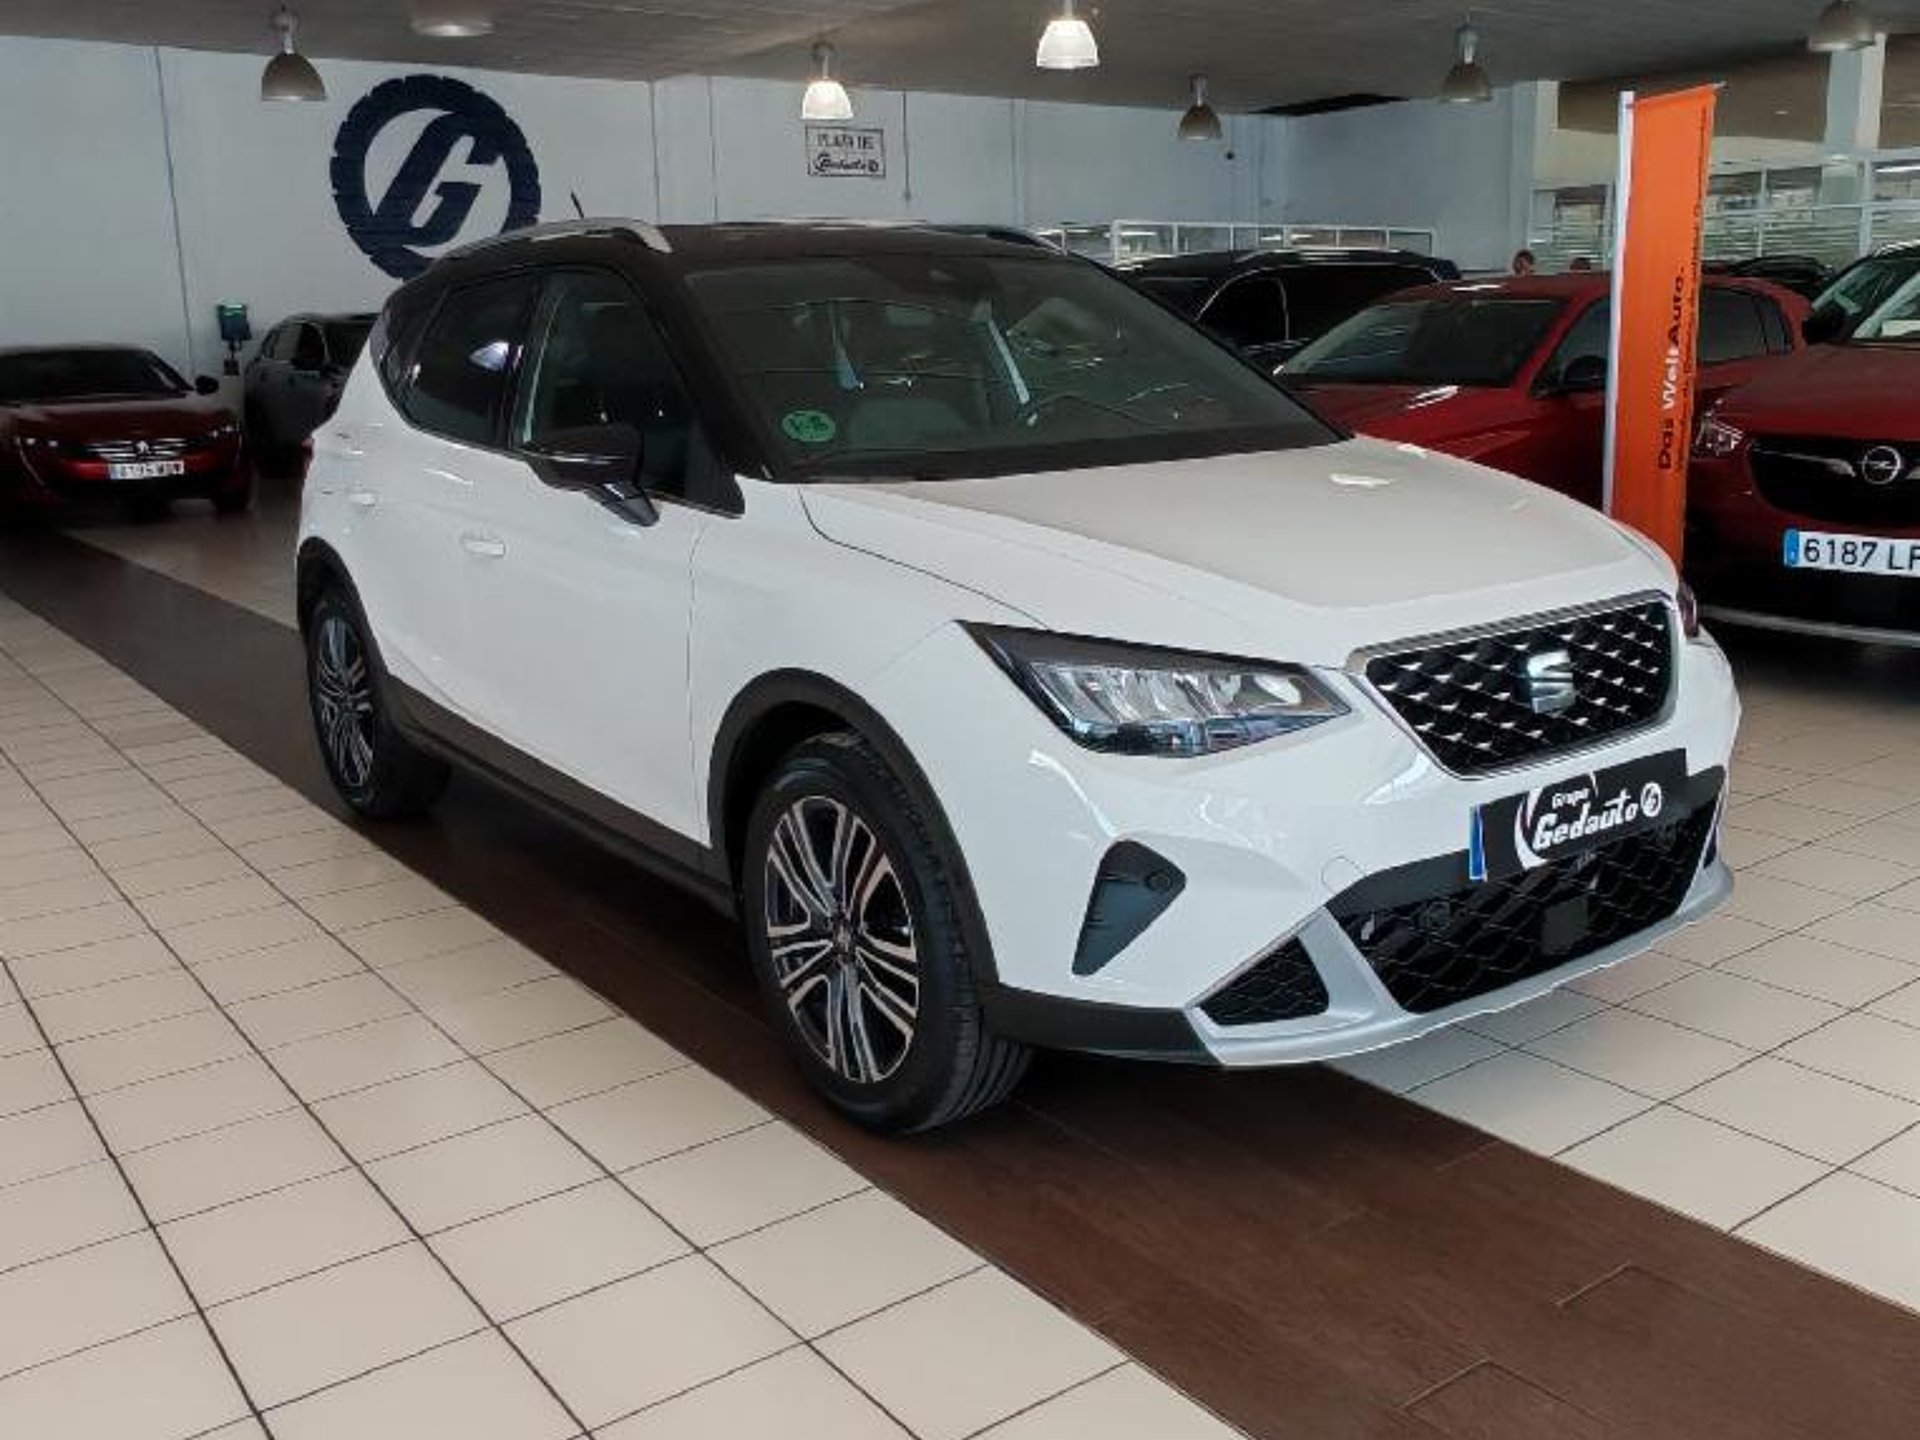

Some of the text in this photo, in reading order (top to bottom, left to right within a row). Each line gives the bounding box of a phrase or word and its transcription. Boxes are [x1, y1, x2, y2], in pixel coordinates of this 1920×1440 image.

[1657, 417, 1674, 470] Das
[1803, 538, 1878, 567] 6187
[1532, 788, 1639, 851] Gedauto
